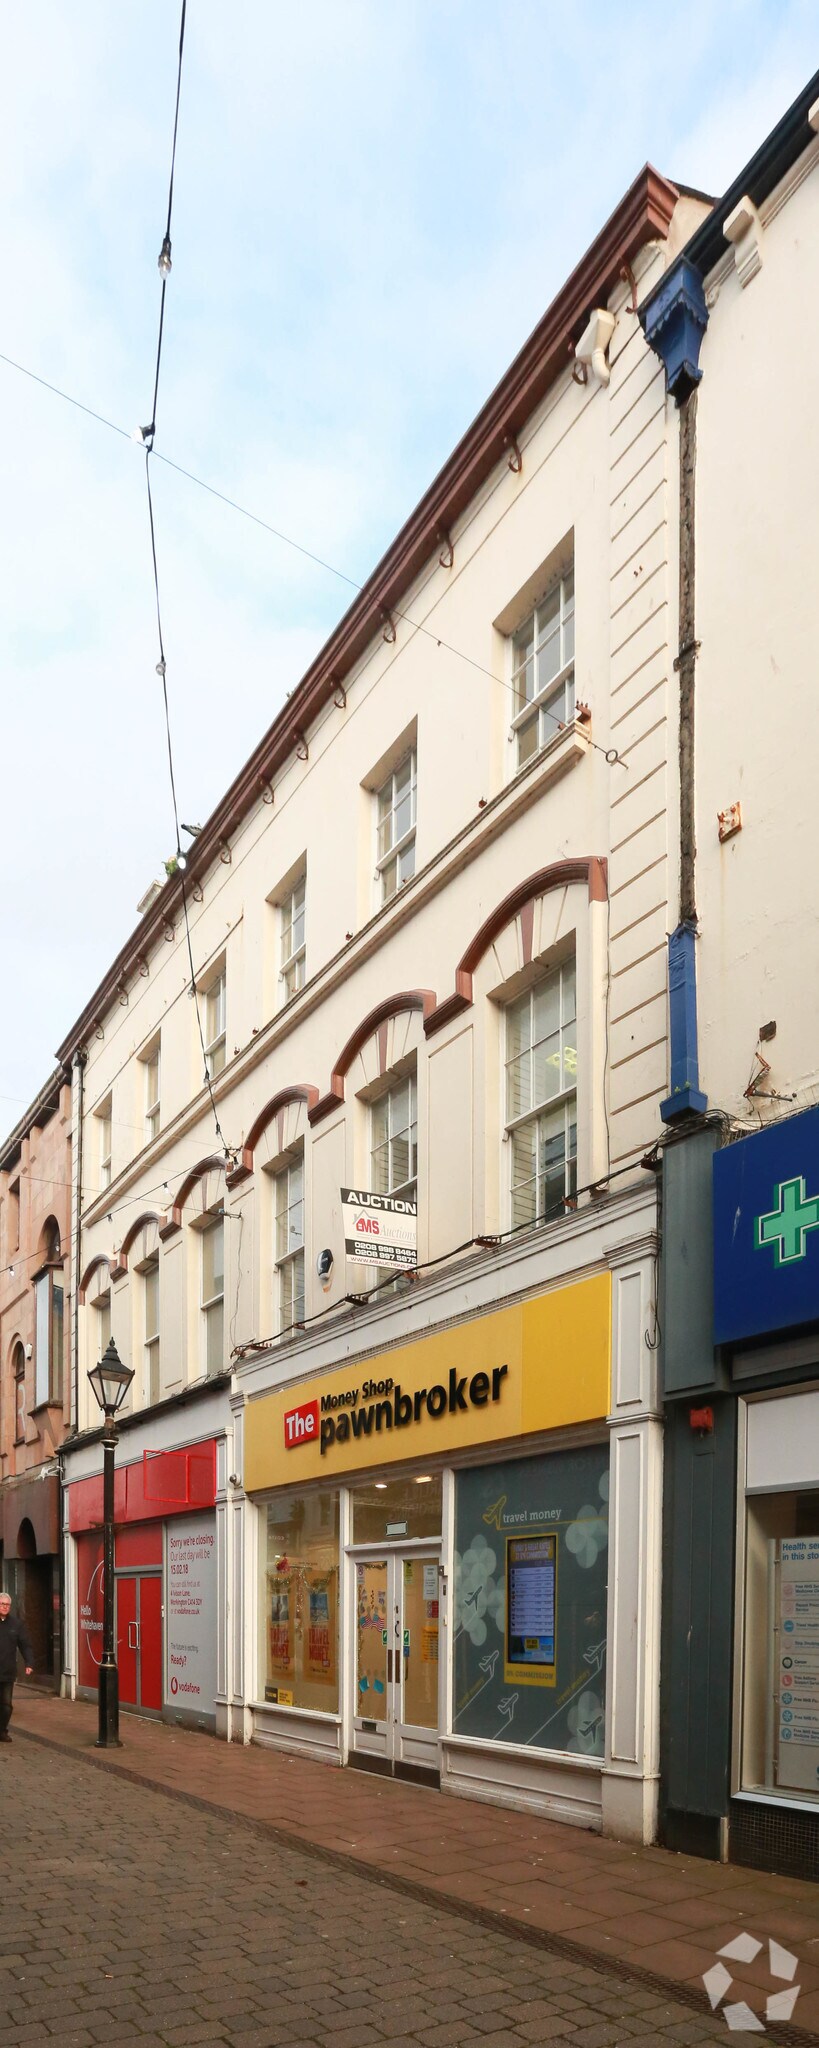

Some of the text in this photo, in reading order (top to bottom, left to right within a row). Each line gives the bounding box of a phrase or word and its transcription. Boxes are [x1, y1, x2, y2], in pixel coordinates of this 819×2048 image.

[347, 1191, 417, 1215] AUCTION
[380, 1225, 417, 1241] Auctions
[354, 1242, 377, 1251] 0208
[354, 1248, 378, 1258] 0208
[320, 1377, 394, 1412] Money Shop
[320, 1364, 508, 1455] pawnbroker
[286, 1412, 314, 1440] The
[503, 1509, 562, 1523] travel money
[170, 1538, 182, 1549] Sorry
[183, 1537, 195, 1546] we're
[170, 1564, 188, 1574] 15.02.18
[80, 1604, 92, 1616] Hello
[80, 1619, 104, 1630] Whitehaven
[515, 1670, 554, 1680] COMMISSION
[178, 1682, 200, 1694] vodafone
